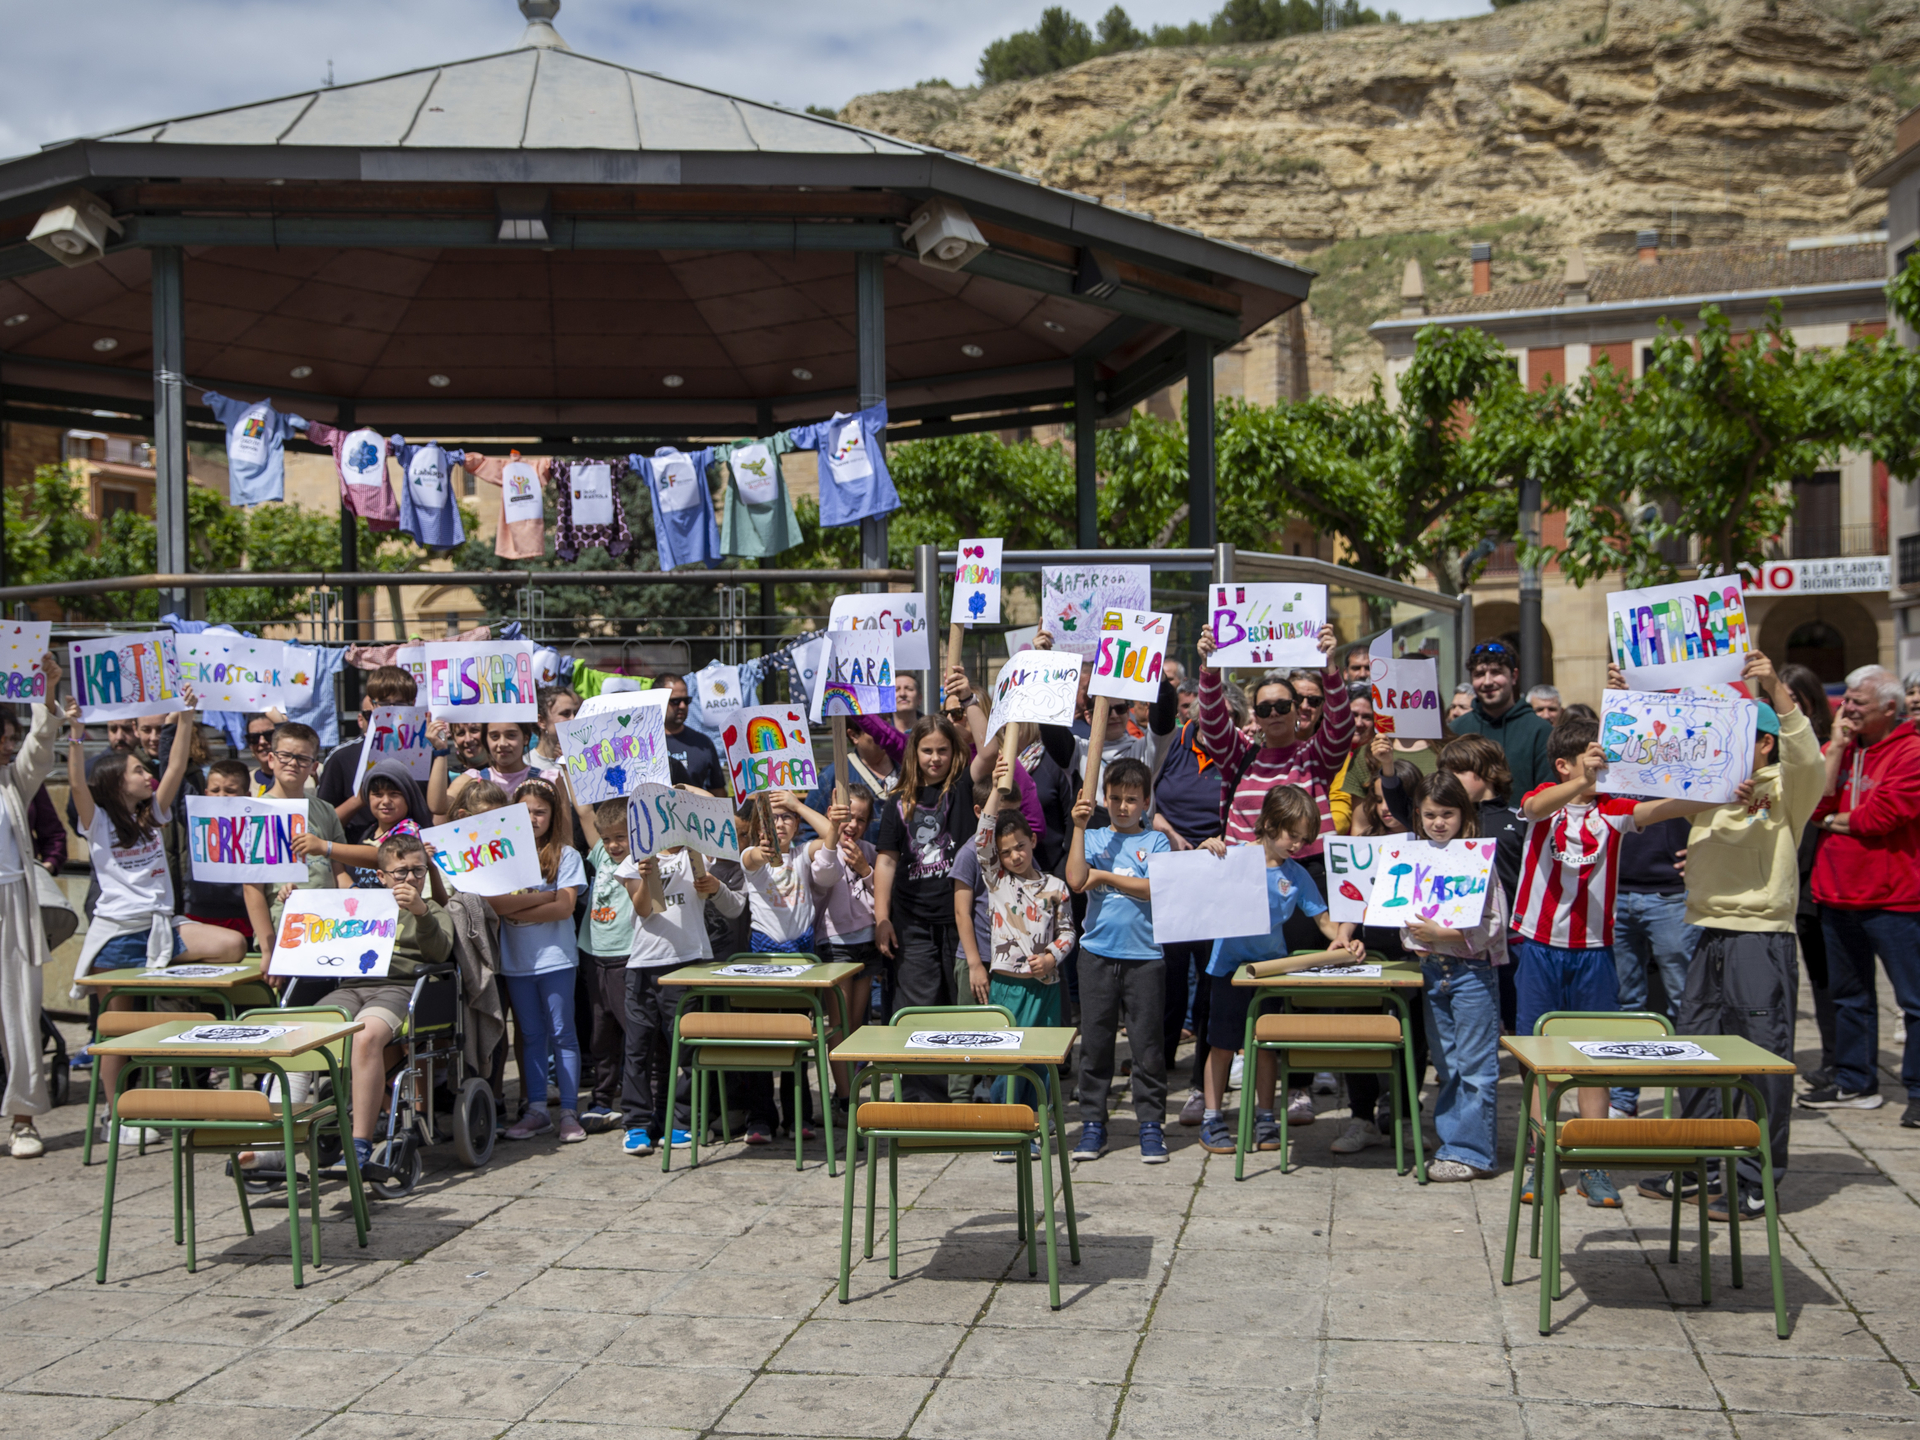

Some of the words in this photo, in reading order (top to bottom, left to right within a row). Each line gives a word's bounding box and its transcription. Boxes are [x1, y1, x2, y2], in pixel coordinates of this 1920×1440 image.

[955, 564, 1000, 585] TASUNA
[1043, 569, 1126, 598] NAFARROA
[1833, 561, 1885, 574] PLANTA
[1613, 586, 1749, 670] NAFARROA
[180, 661, 282, 687] IKASTOLAK
[431, 652, 535, 706] EUSKARA
[1094, 636, 1163, 683] STOLA
[706, 697, 740, 709] ARGIA
[567, 732, 657, 775] NAFARROA!
[1601, 711, 1708, 766] EUSKARA
[722, 724, 817, 804] EUSKARA
[433, 837, 515, 876] EUSKARA
[1382, 862, 1486, 908] IKASTOLA
[279, 912, 396, 949] ETORKIZUNA
